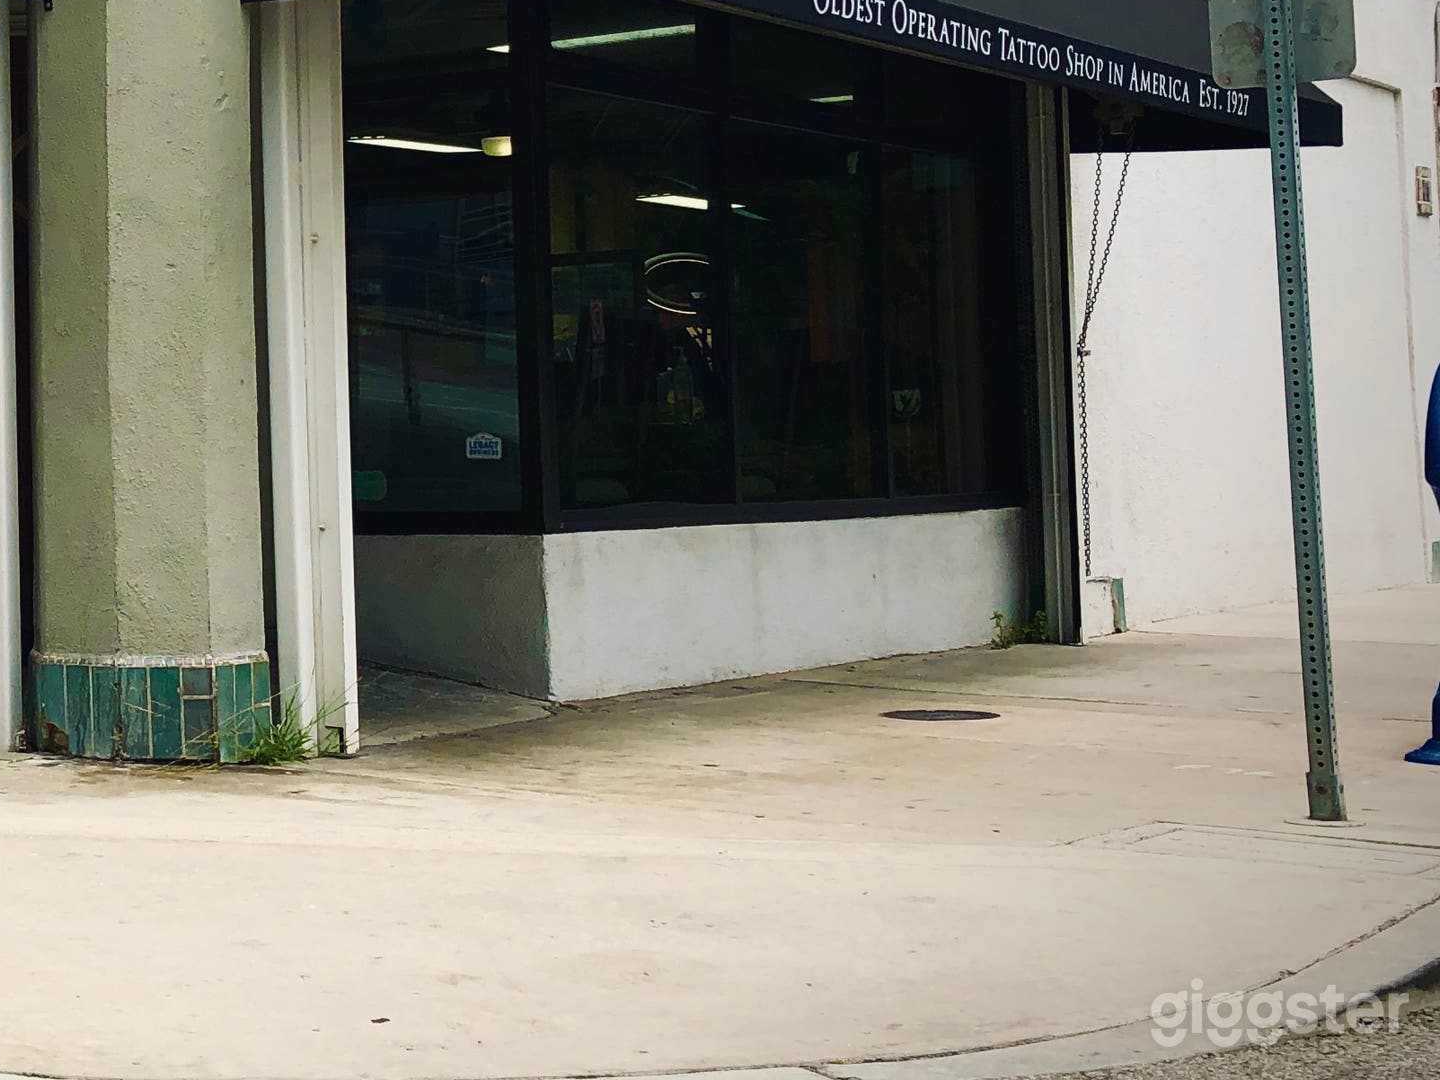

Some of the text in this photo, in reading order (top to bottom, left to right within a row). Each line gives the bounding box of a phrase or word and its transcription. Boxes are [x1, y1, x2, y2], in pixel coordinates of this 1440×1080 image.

[998, 27, 1060, 71] TATTOO
[1065, 45, 1103, 82] SHOP
[1108, 61, 1124, 87] IN
[1128, 62, 1190, 104] AMERICA
[1199, 79, 1223, 110] EST.
[1227, 90, 1250, 117] 1927
